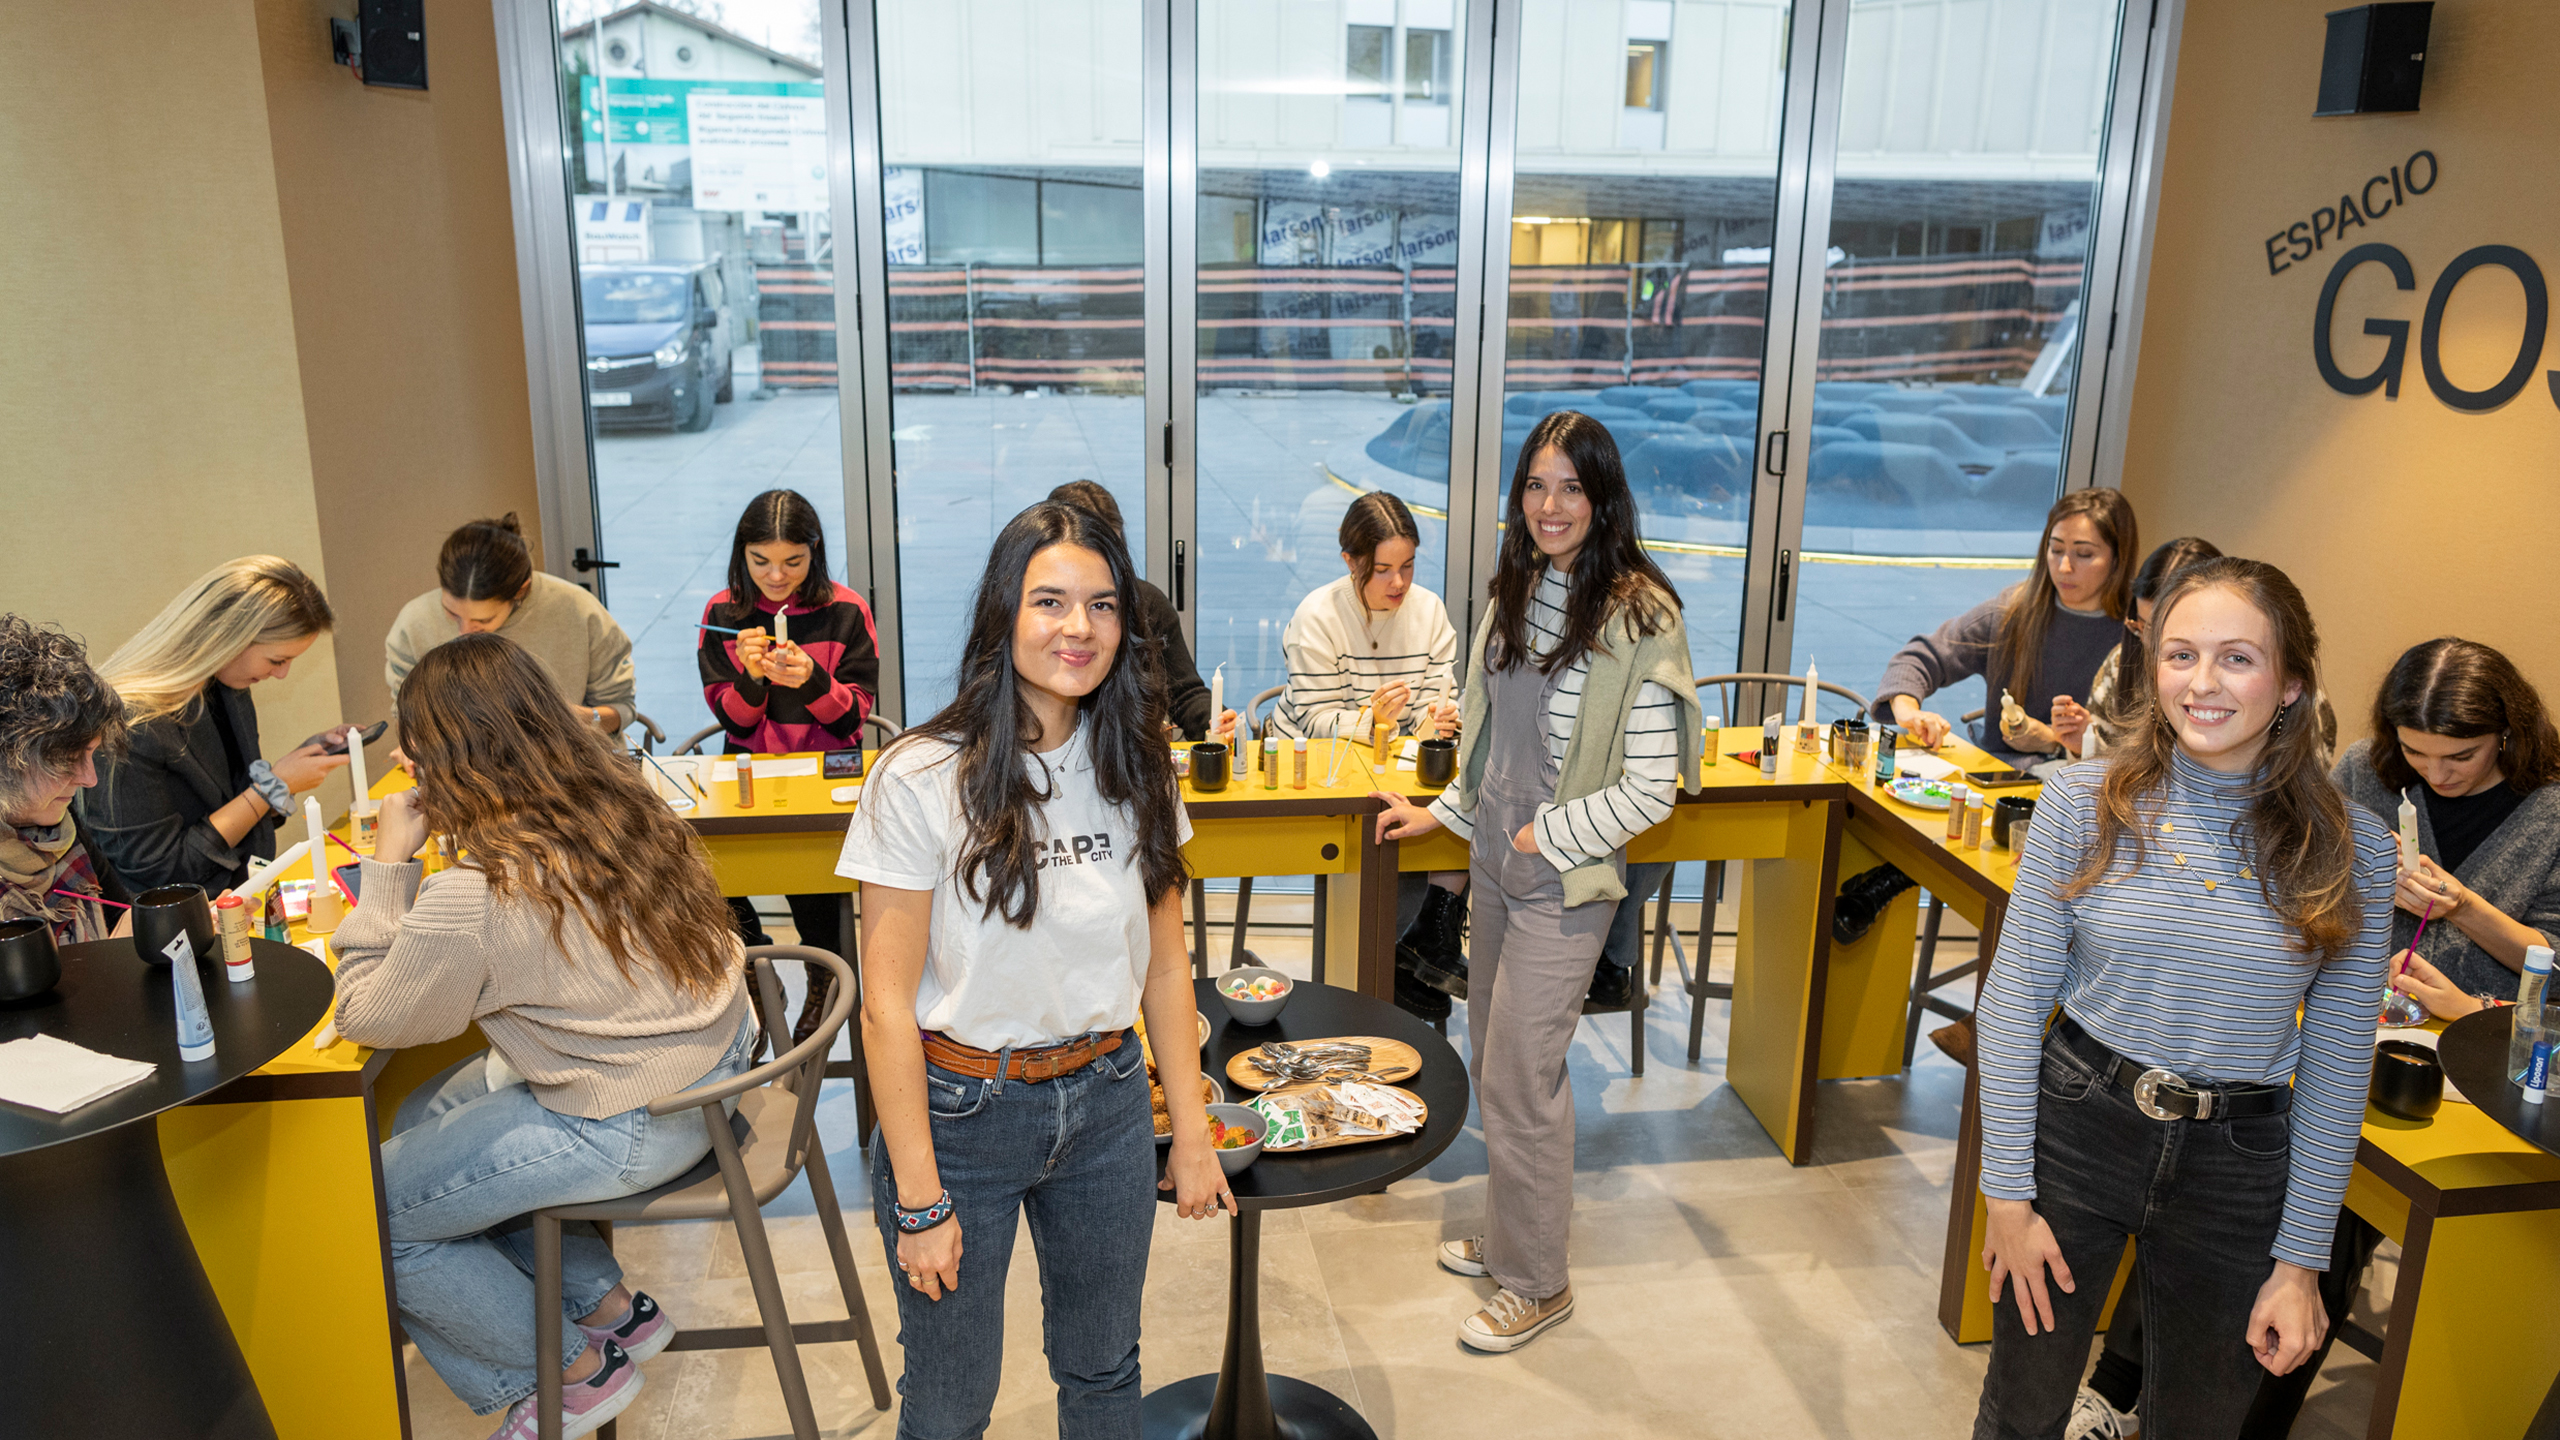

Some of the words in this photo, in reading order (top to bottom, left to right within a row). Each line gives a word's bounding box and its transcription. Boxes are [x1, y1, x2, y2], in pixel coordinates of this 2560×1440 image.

[2265, 150, 2438, 276] ESPACIO
[2313, 242, 2560, 414] GO
[1051, 855, 1074, 867] THE
[1091, 850, 1113, 862] CITY
[2530, 1056, 2544, 1088] Liposan
